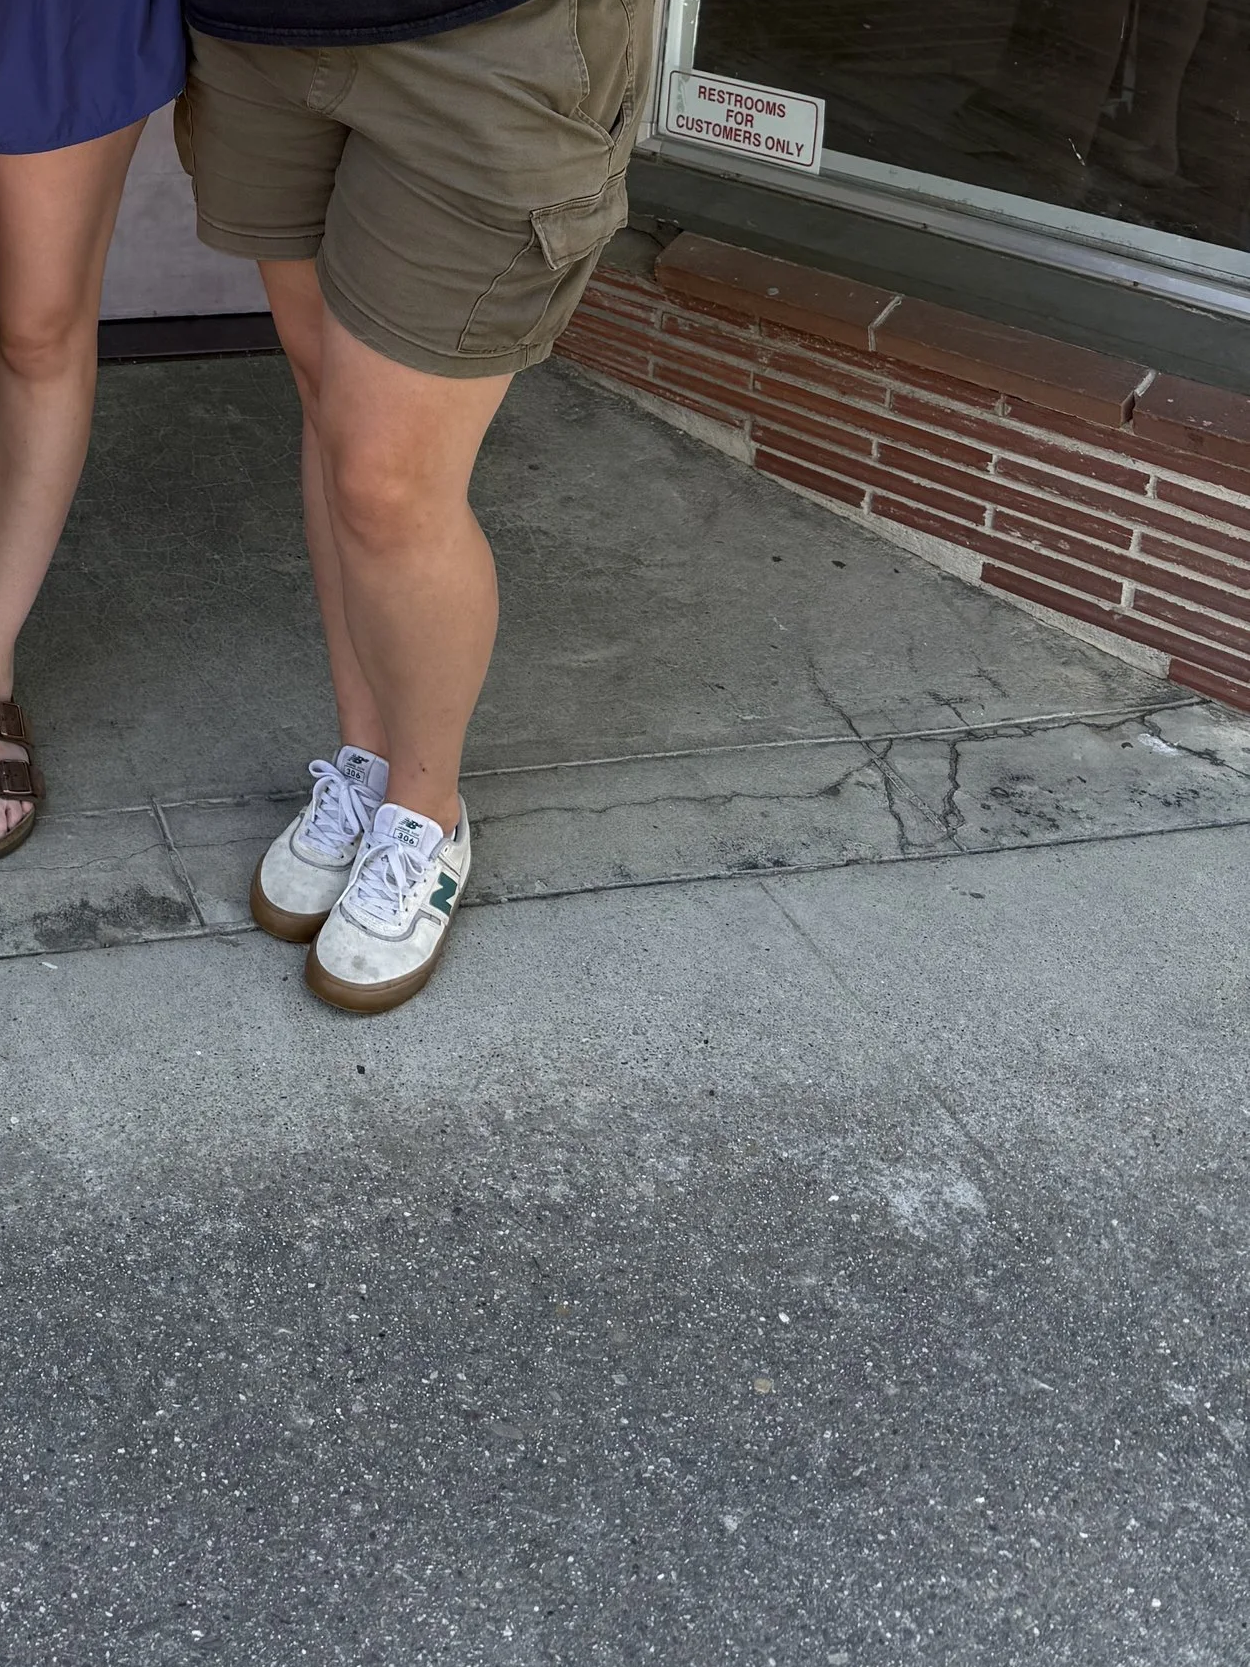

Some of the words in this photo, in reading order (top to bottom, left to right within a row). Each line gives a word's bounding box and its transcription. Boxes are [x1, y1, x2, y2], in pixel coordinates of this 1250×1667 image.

[698, 85, 786, 118] RESTROOMS
[726, 109, 754, 128] FOR
[675, 114, 762, 147] CUSTOMERS
[764, 136, 805, 158] ONLY
[397, 831, 415, 845] 306
